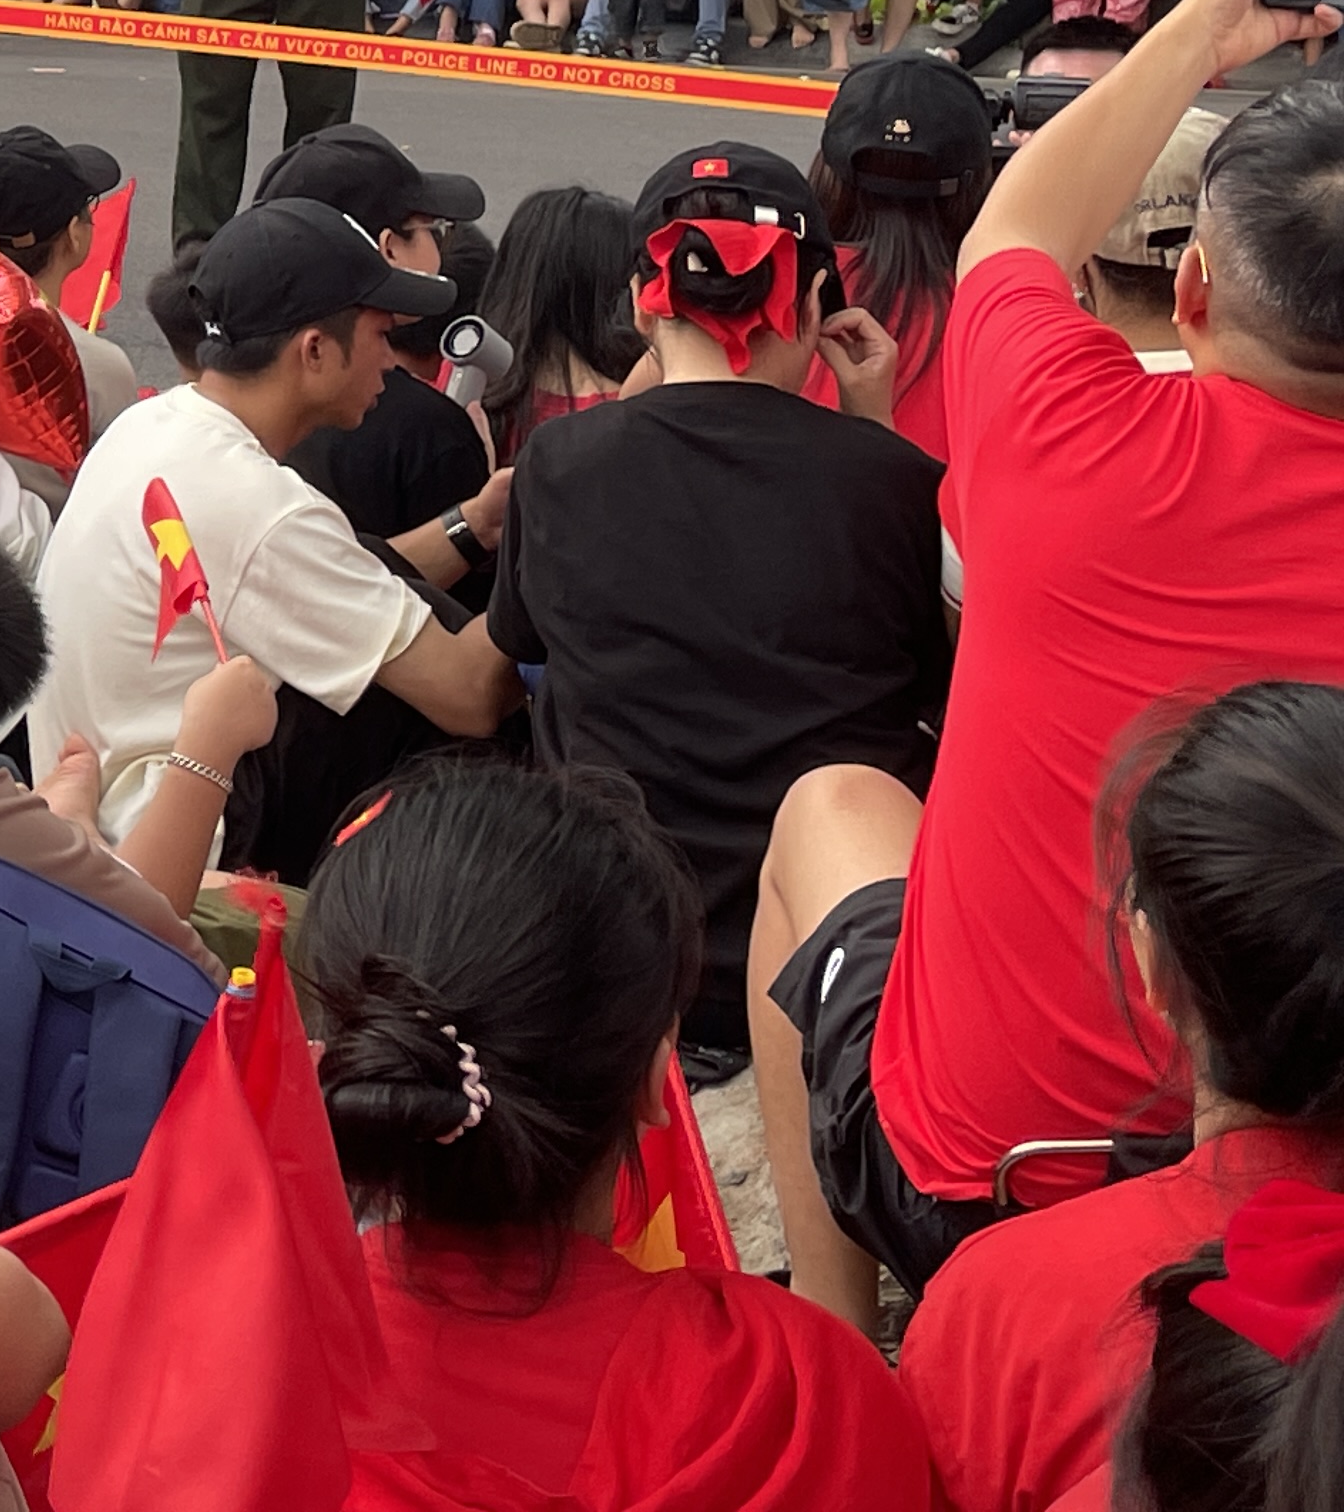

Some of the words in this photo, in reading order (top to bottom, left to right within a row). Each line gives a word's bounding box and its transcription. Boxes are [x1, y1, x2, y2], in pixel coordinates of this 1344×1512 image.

[45, 13, 93, 31] HÀNG
[99, 17, 136, 37] RÀO
[285, 38, 340, 56] VƯỢT
[345, 44, 384, 61] QUA
[402, 49, 469, 71] POLICE
[475, 57, 523, 76] LINE.
[529, 63, 557, 79] DO
[563, 66, 602, 84] NOT
[608, 71, 676, 92] CROSS
